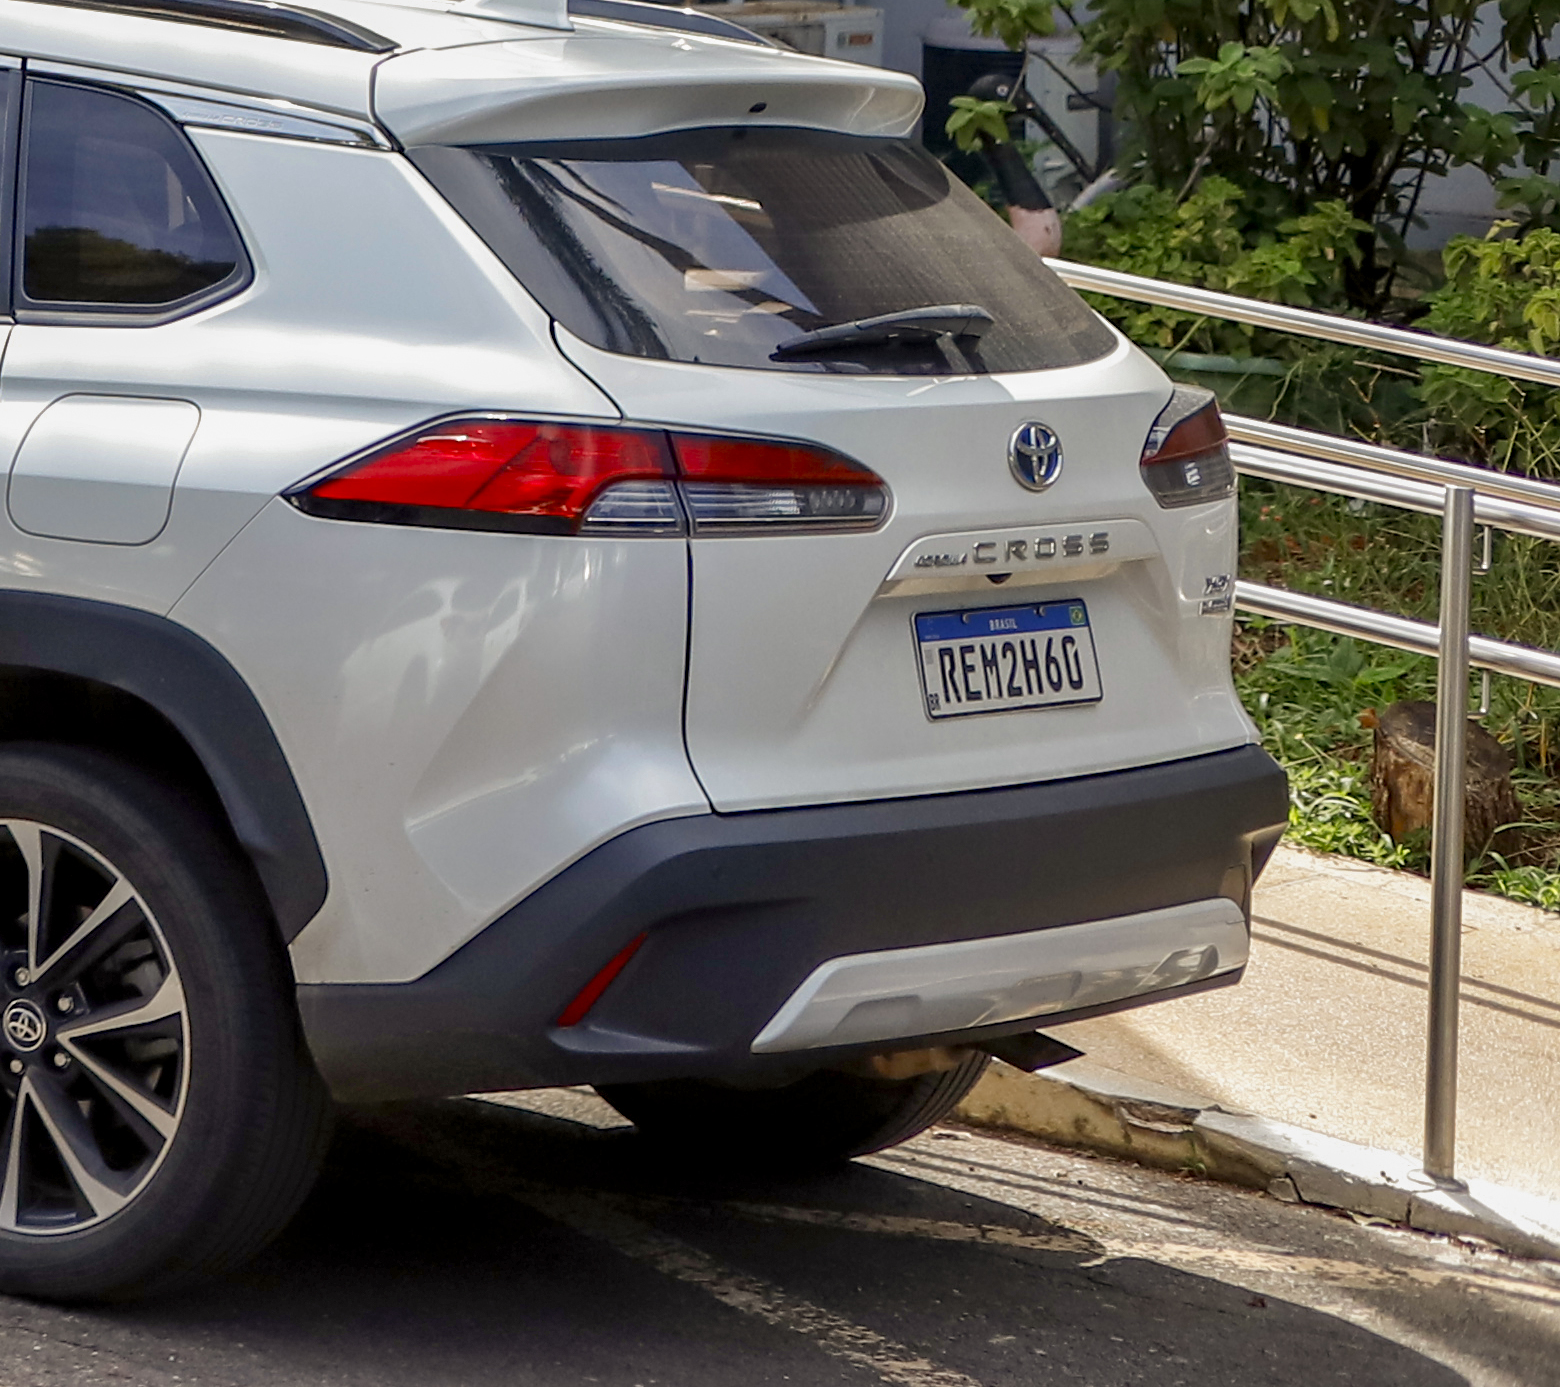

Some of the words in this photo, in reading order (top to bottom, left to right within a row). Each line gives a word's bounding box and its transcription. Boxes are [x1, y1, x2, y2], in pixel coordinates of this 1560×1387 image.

[972, 531, 1110, 564] CROSS
[989, 617, 1018, 631] BRASIL
[938, 634, 1084, 704] REM2H60
